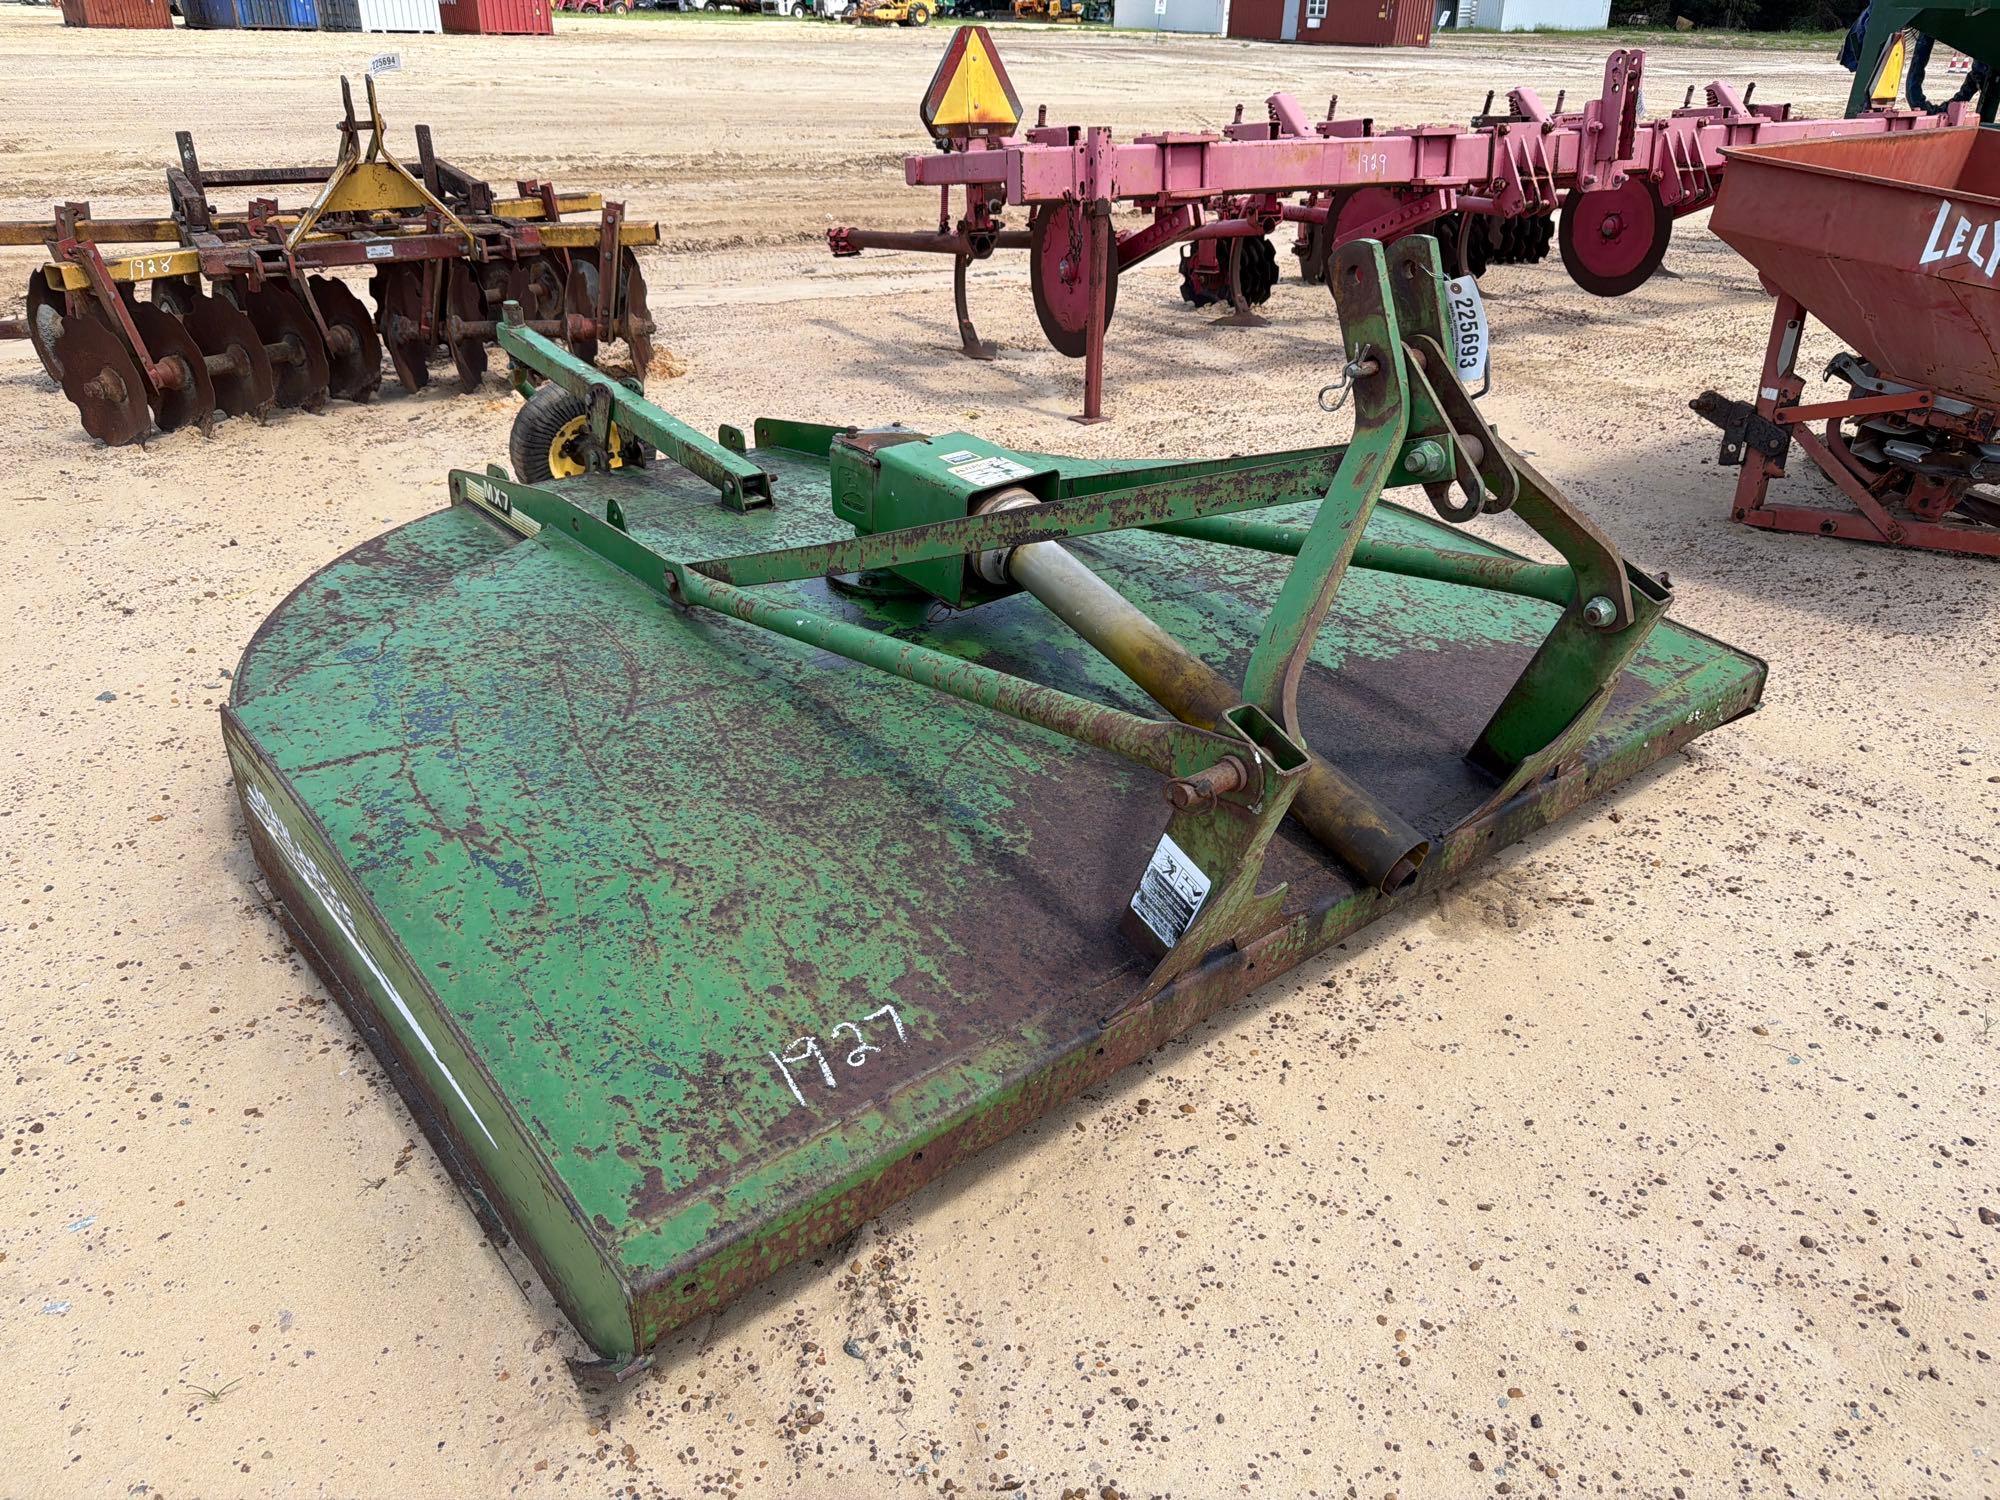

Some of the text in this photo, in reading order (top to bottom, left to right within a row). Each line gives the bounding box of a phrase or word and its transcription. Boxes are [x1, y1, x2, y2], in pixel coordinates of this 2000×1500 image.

[1358, 153, 1387, 175] 1929
[130, 255, 173, 280] 1928
[1455, 298, 1480, 369] 225693
[482, 480, 509, 511] MX7
[769, 1004, 908, 1107] 1927
